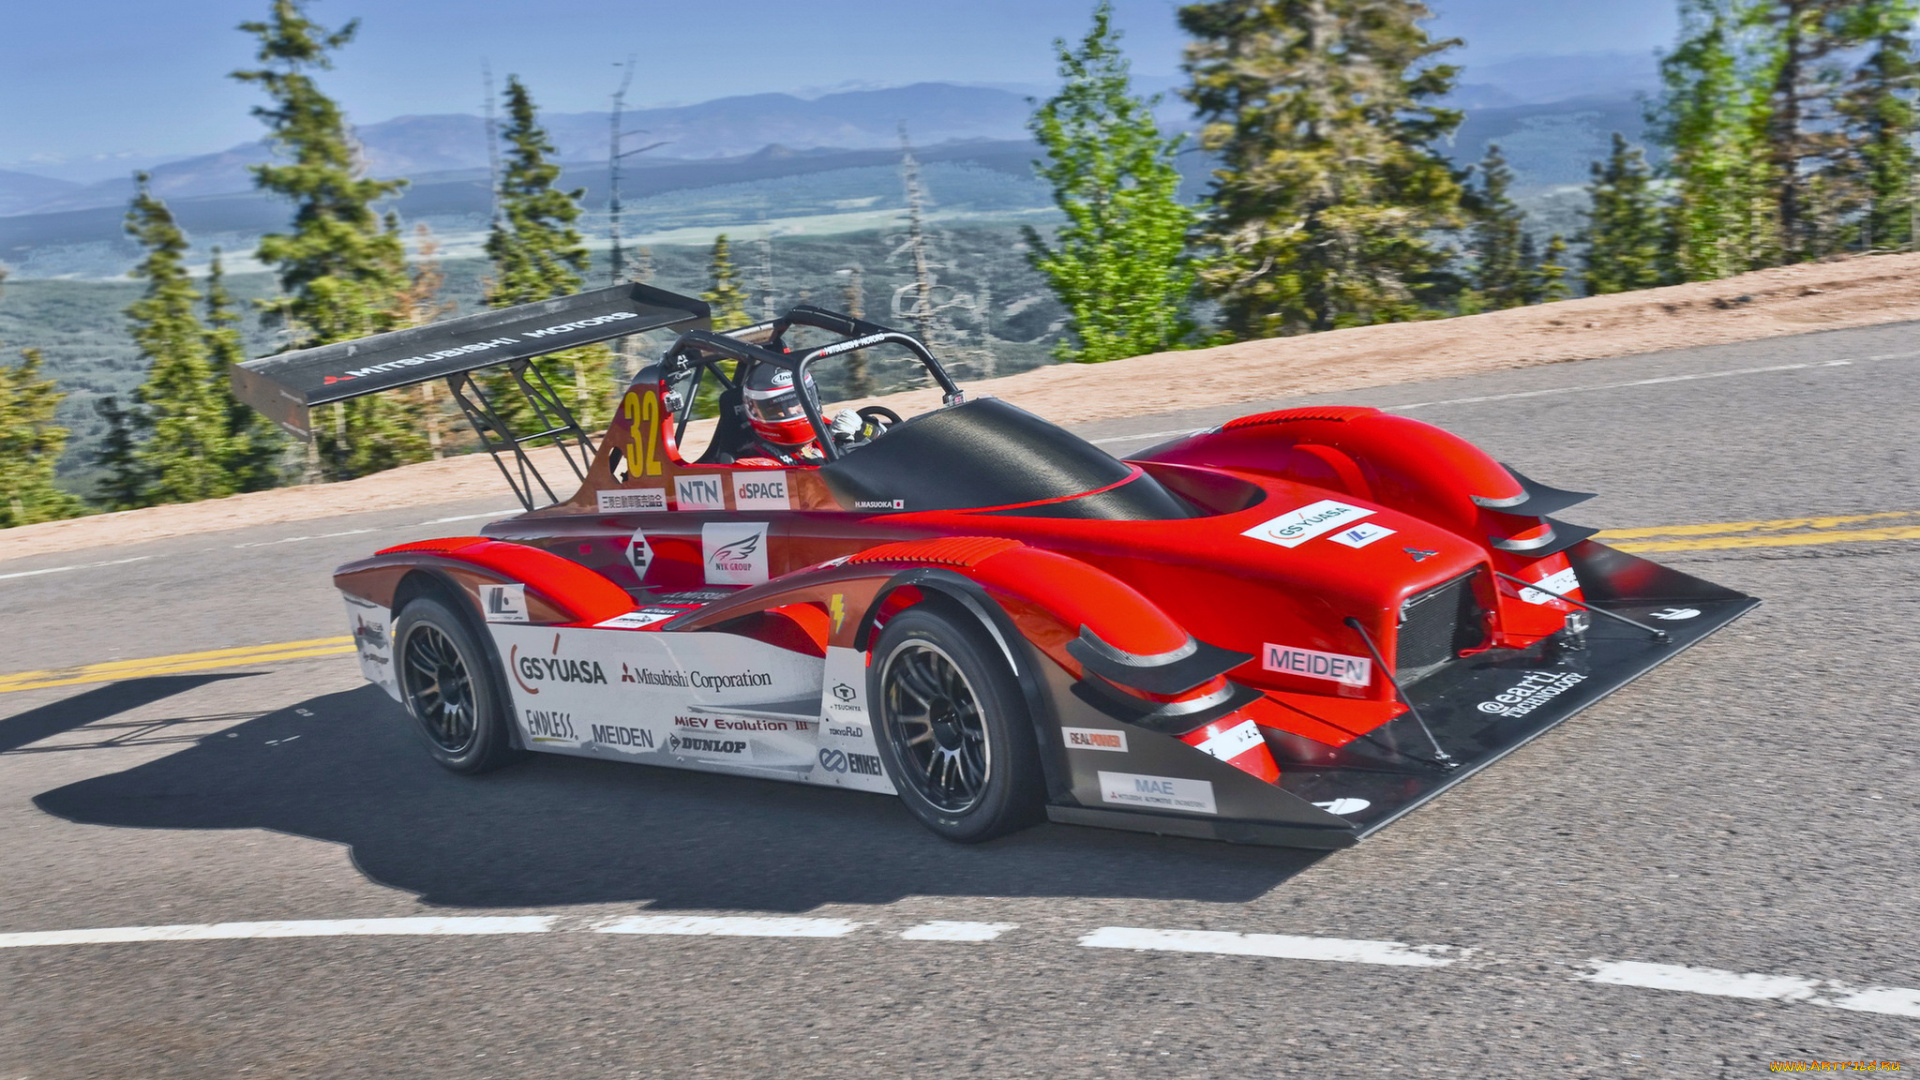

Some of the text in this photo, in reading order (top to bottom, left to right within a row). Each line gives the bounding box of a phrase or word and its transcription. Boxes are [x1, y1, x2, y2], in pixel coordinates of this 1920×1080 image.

[345, 311, 638, 377] MITSUBISHI MOTORS
[624, 390, 662, 478] 32
[679, 480, 719, 504] NTN
[739, 482, 785, 499] dSPACE
[715, 562, 751, 571] NYK GROUP
[1270, 648, 1364, 681] MEIDEN
[634, 667, 772, 692] Mitsubishi Corporation
[1500, 672, 1588, 718] TECHNOLOGY
[674, 716, 709, 729] MiEV
[714, 718, 788, 731] Evolution
[591, 724, 655, 748] MEIDEN
[681, 737, 746, 753] DUNLOP
[847, 752, 883, 777] ENKEI
[1135, 779, 1175, 795] MAE
